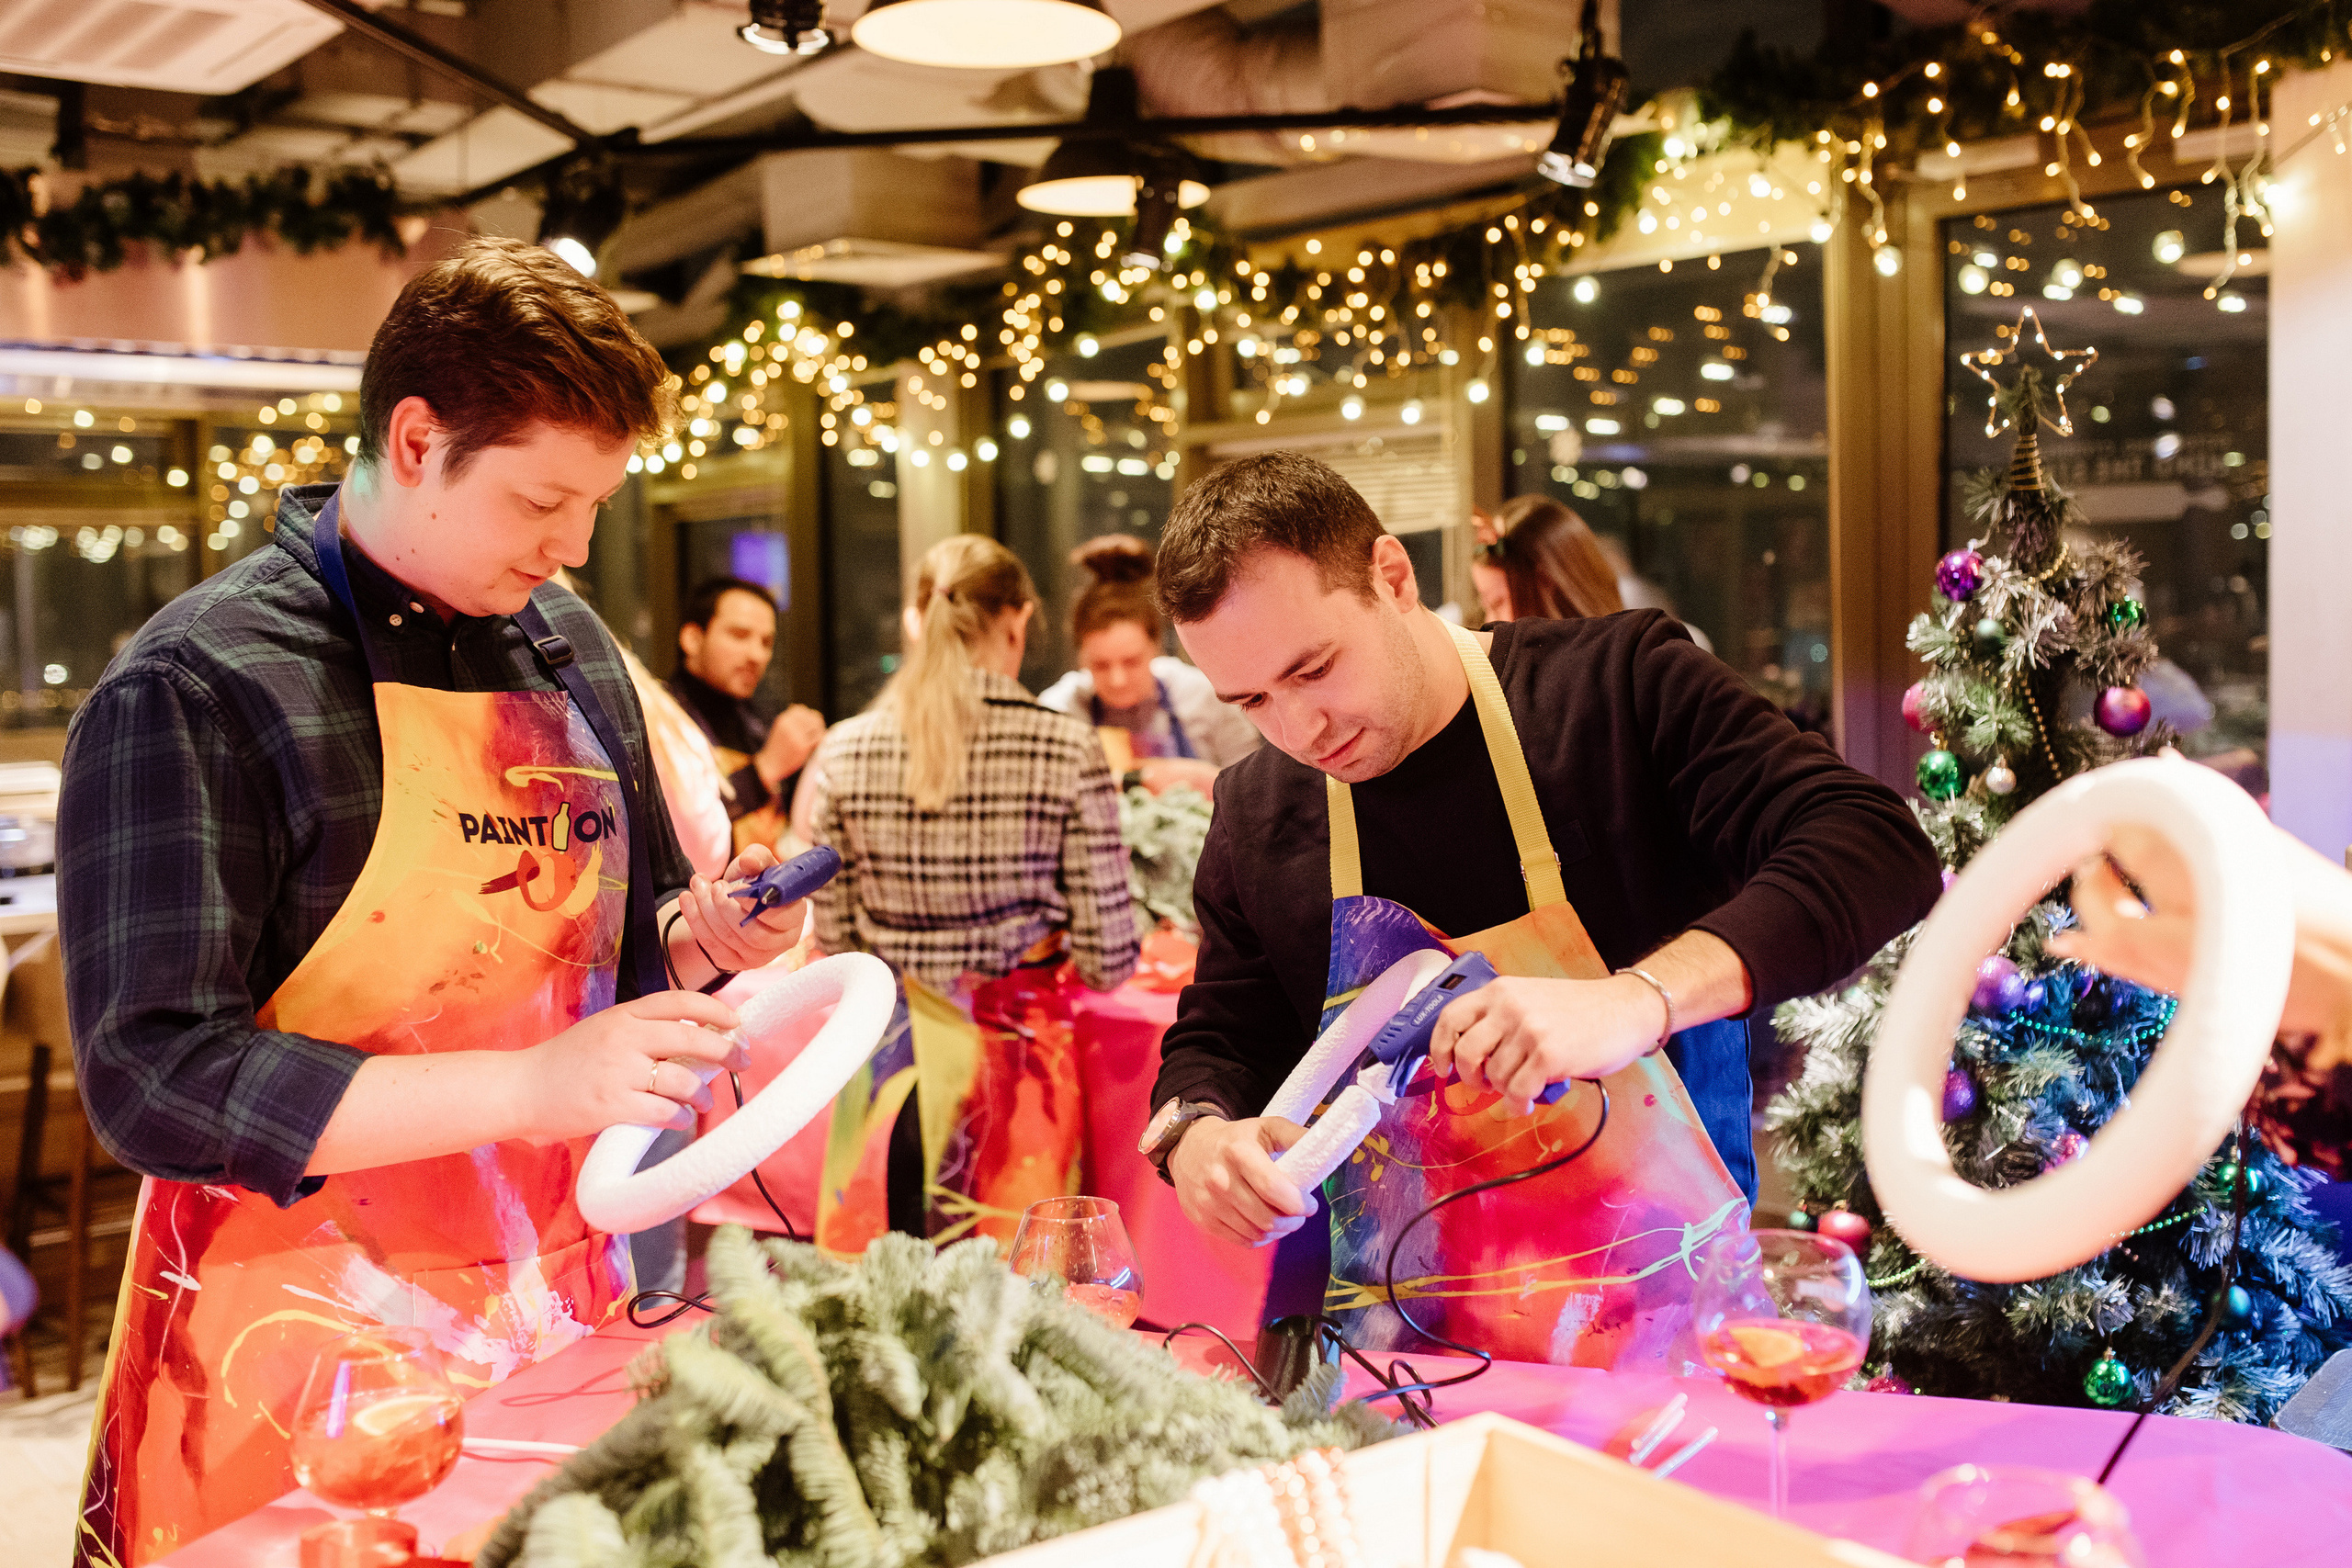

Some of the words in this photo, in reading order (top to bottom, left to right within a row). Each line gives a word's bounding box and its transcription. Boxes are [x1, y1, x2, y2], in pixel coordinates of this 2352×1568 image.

[458, 812, 548, 846] PAINT
[573, 806, 617, 842] ON
[1413, 994, 1443, 1025] LUX-TOOLS
